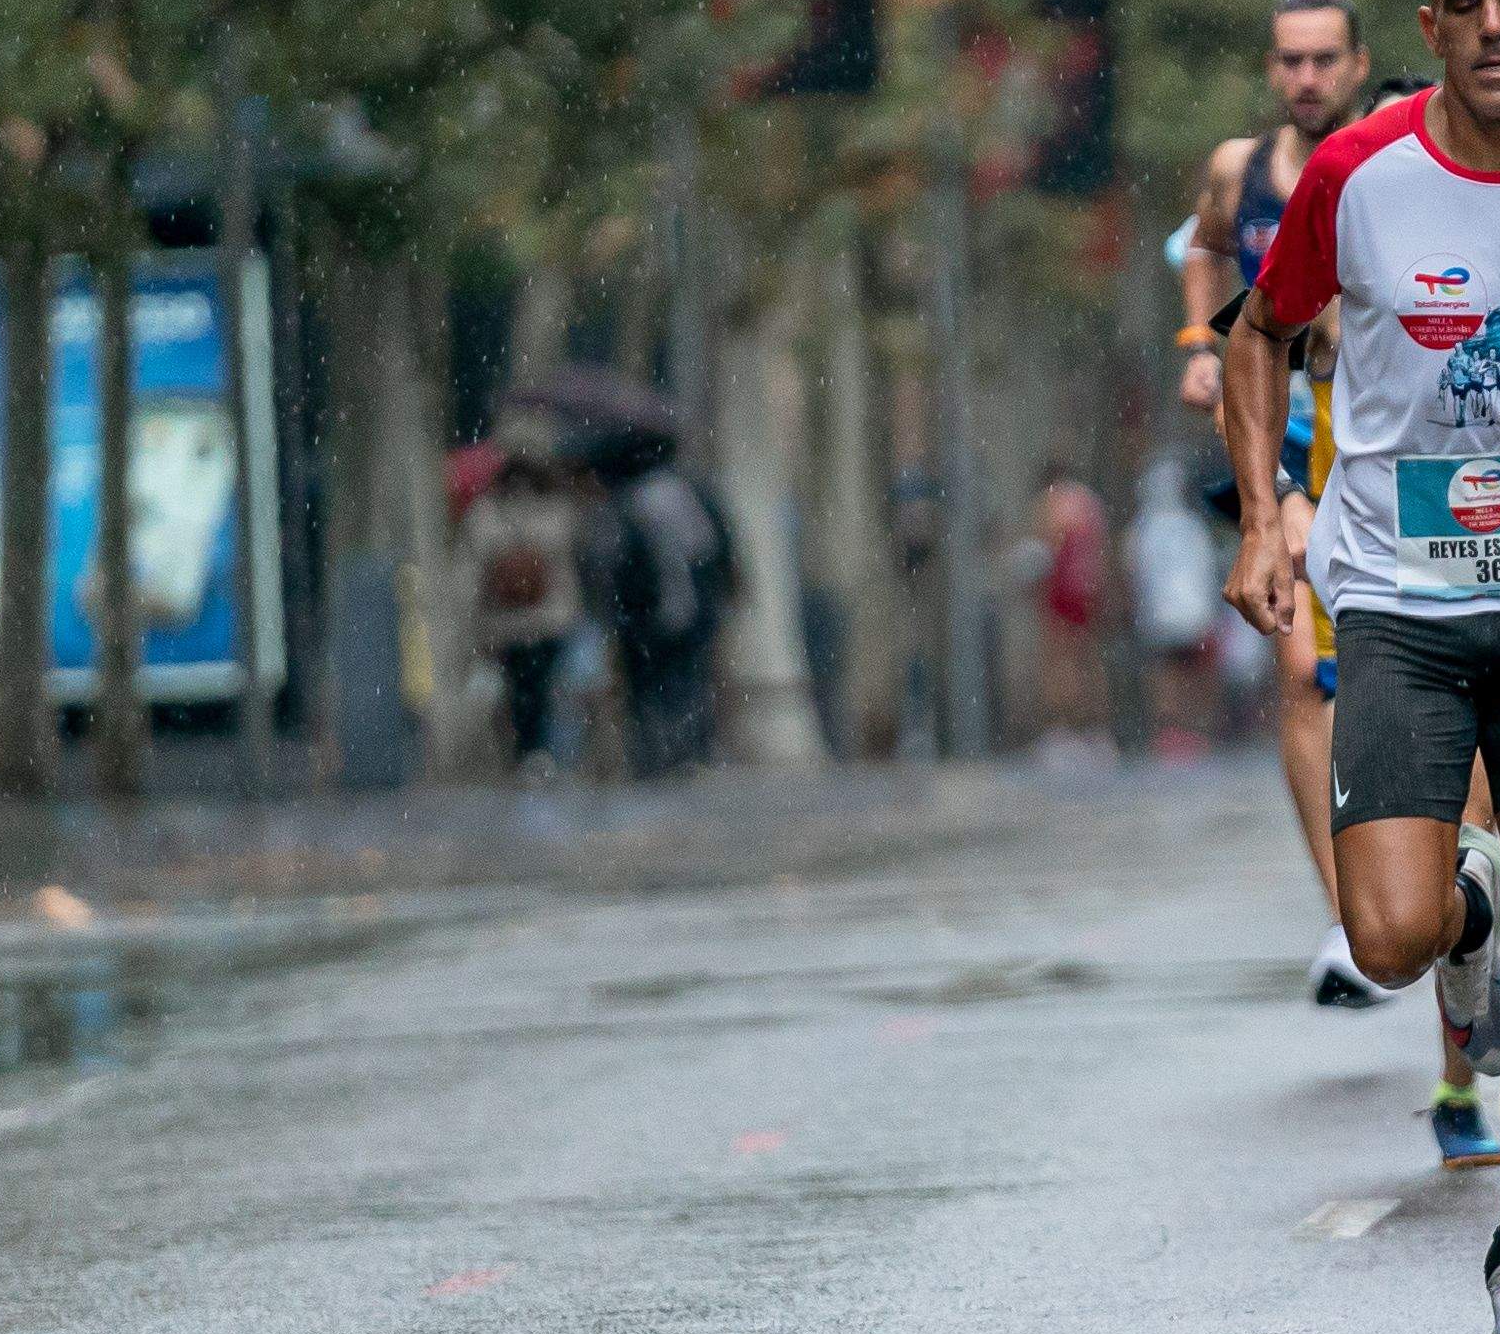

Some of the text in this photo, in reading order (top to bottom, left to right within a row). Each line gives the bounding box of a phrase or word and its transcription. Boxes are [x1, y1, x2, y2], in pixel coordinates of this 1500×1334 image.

[1414, 300, 1470, 310] TotalEnergies
[1427, 317, 1454, 325] MILLA
[1428, 539, 1479, 559] REYES
